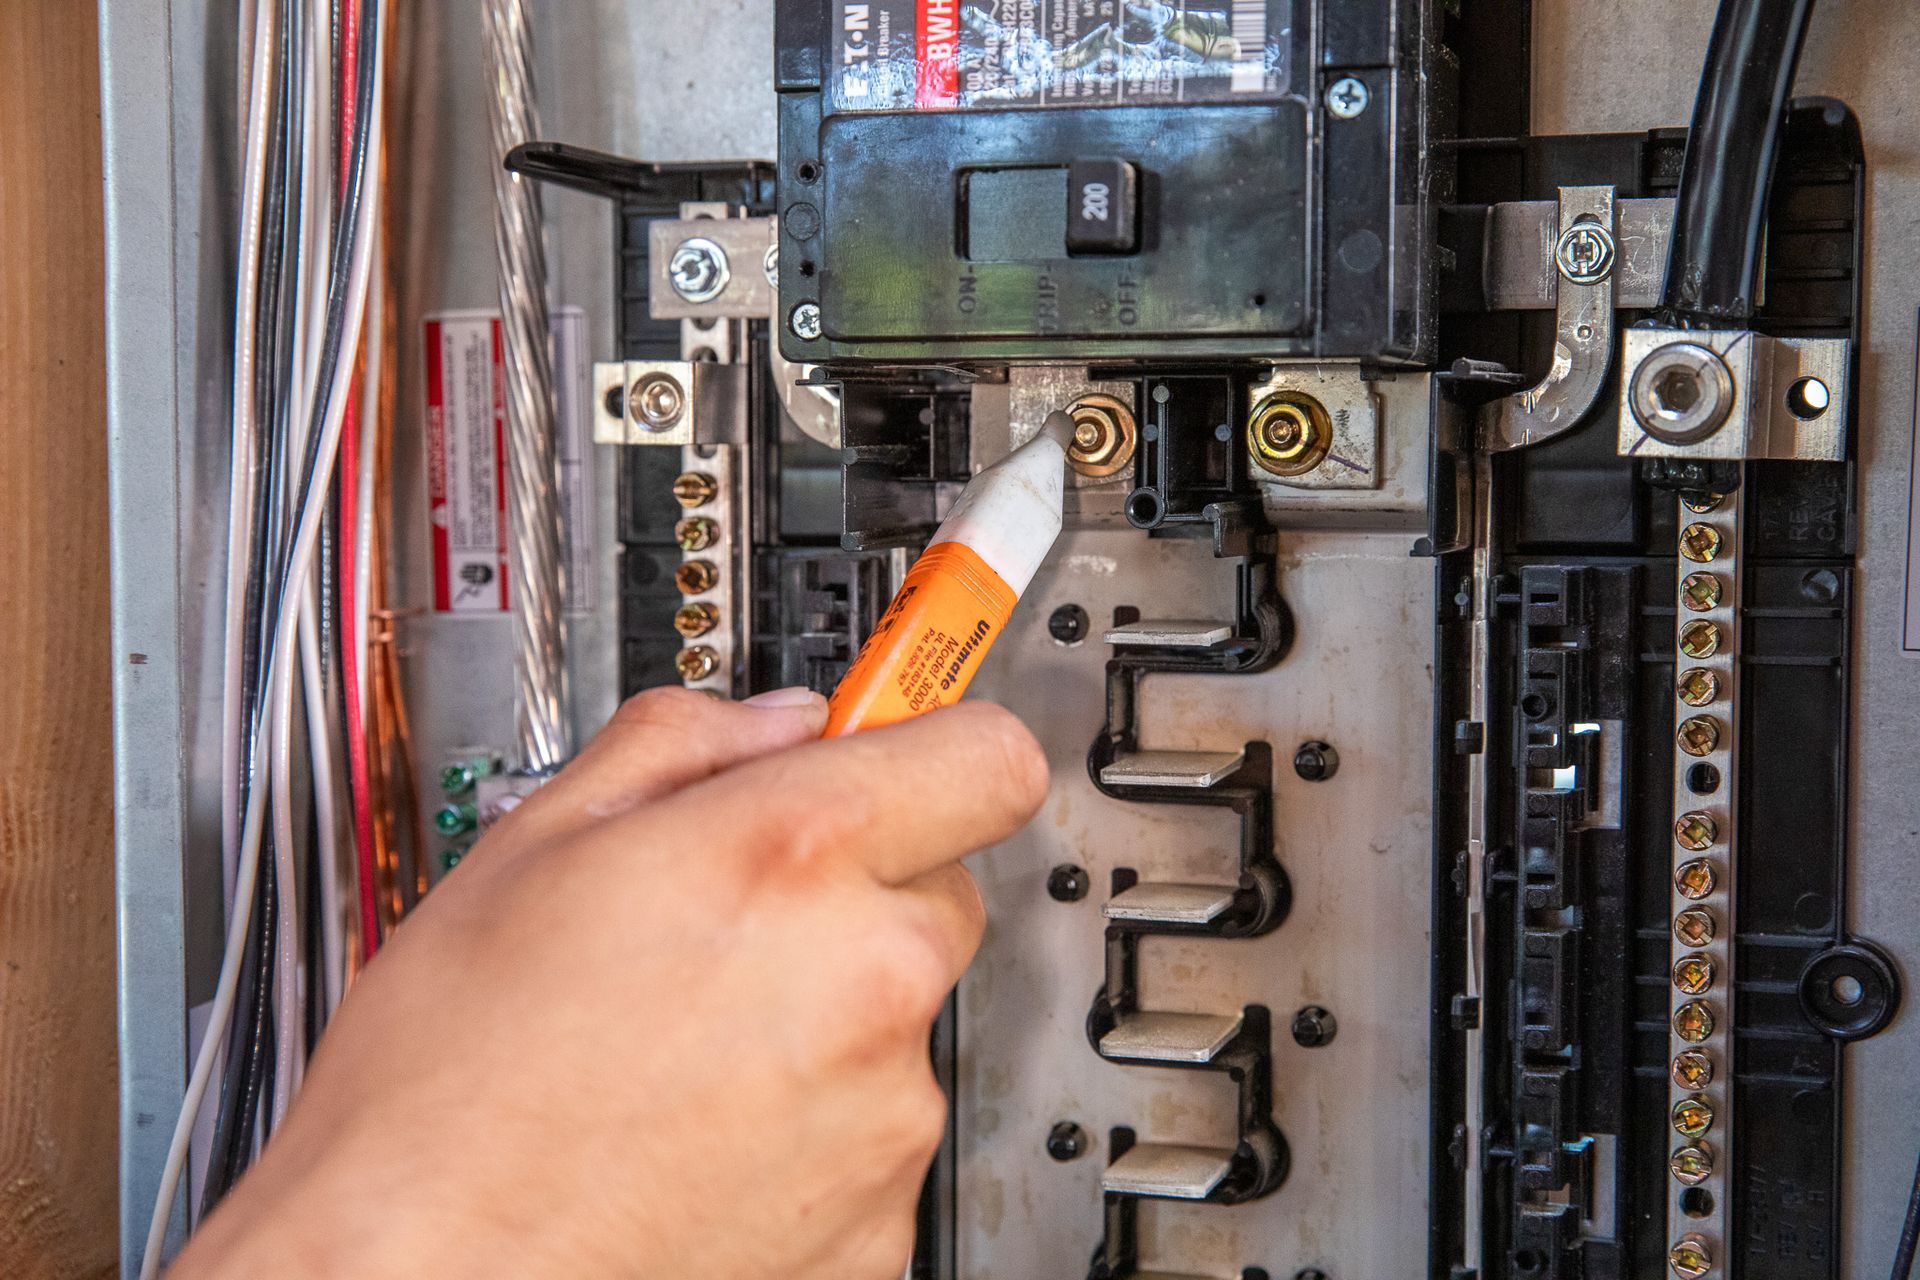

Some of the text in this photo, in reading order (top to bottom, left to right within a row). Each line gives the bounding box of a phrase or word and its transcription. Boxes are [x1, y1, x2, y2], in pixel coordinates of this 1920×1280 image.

[876, 9, 889, 57] Breaker
[984, 38, 1000, 98] 20/240
[1082, 183, 1110, 222] 200
[959, 275, 978, 314] ON
[1117, 276, 1139, 327] OFF
[908, 636, 959, 712] Model 3000
[940, 619, 991, 691] Ultimate
